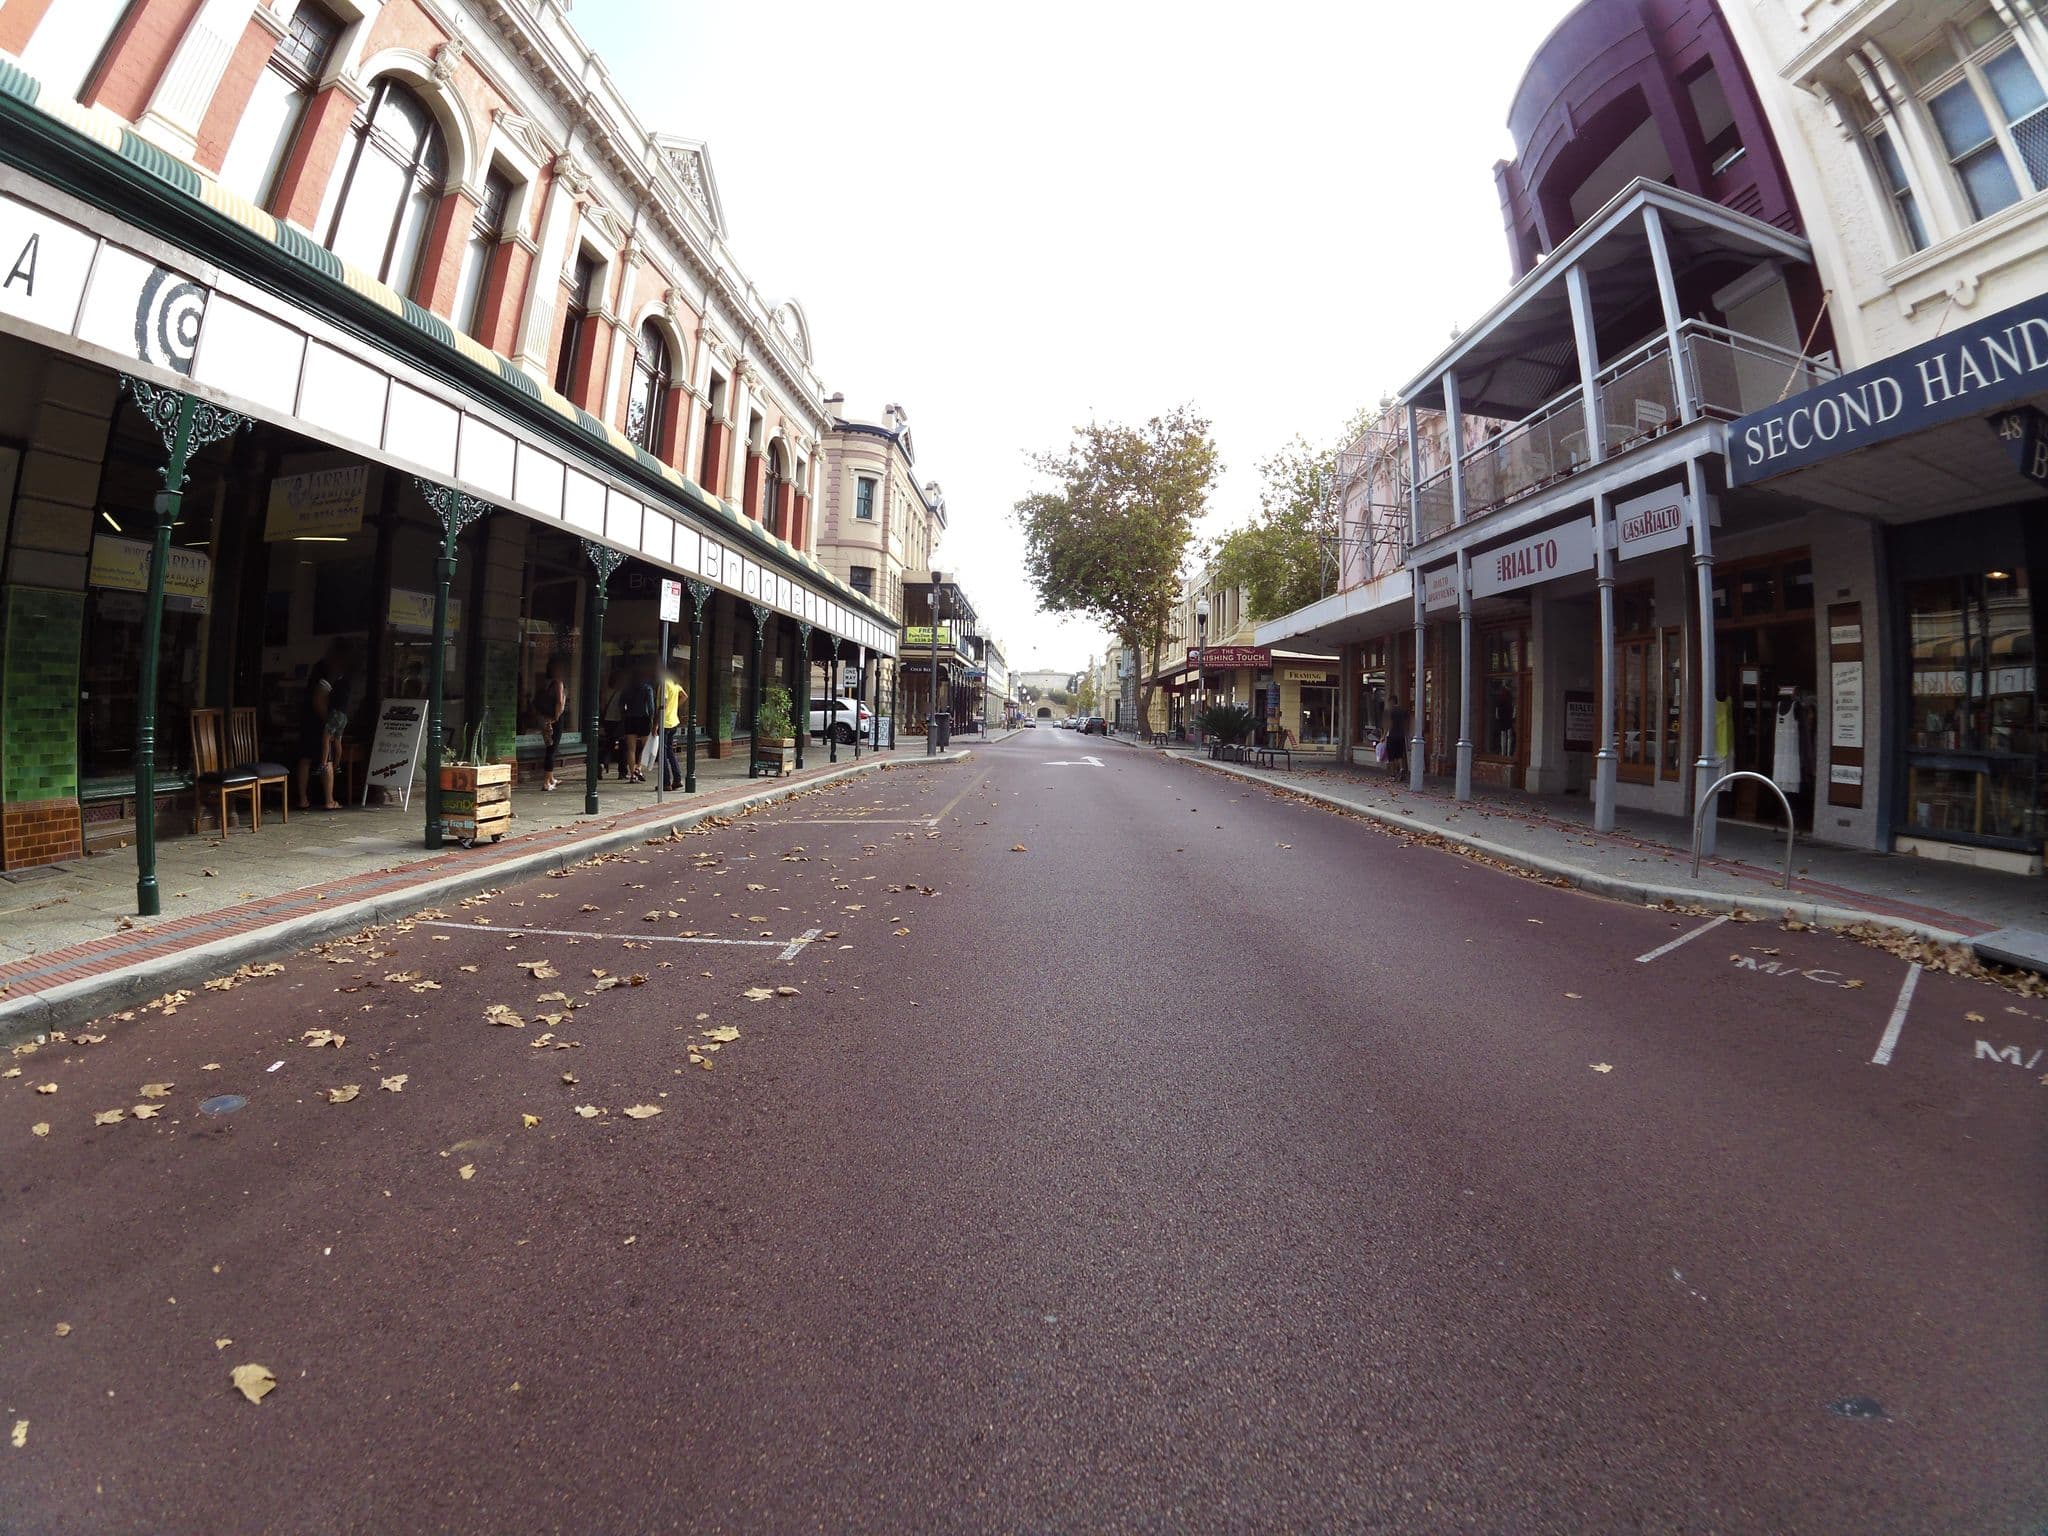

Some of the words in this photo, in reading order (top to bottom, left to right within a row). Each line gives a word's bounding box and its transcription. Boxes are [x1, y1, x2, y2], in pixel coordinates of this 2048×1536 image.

[1745, 376, 1903, 467] SECOND
[1914, 318, 2048, 408] HAND
[2000, 415, 2024, 440] 48
[1501, 538, 1558, 582] RIALTO
[1236, 653, 1266, 661] TOUCH
[1289, 671, 1321, 680] FRAMING
